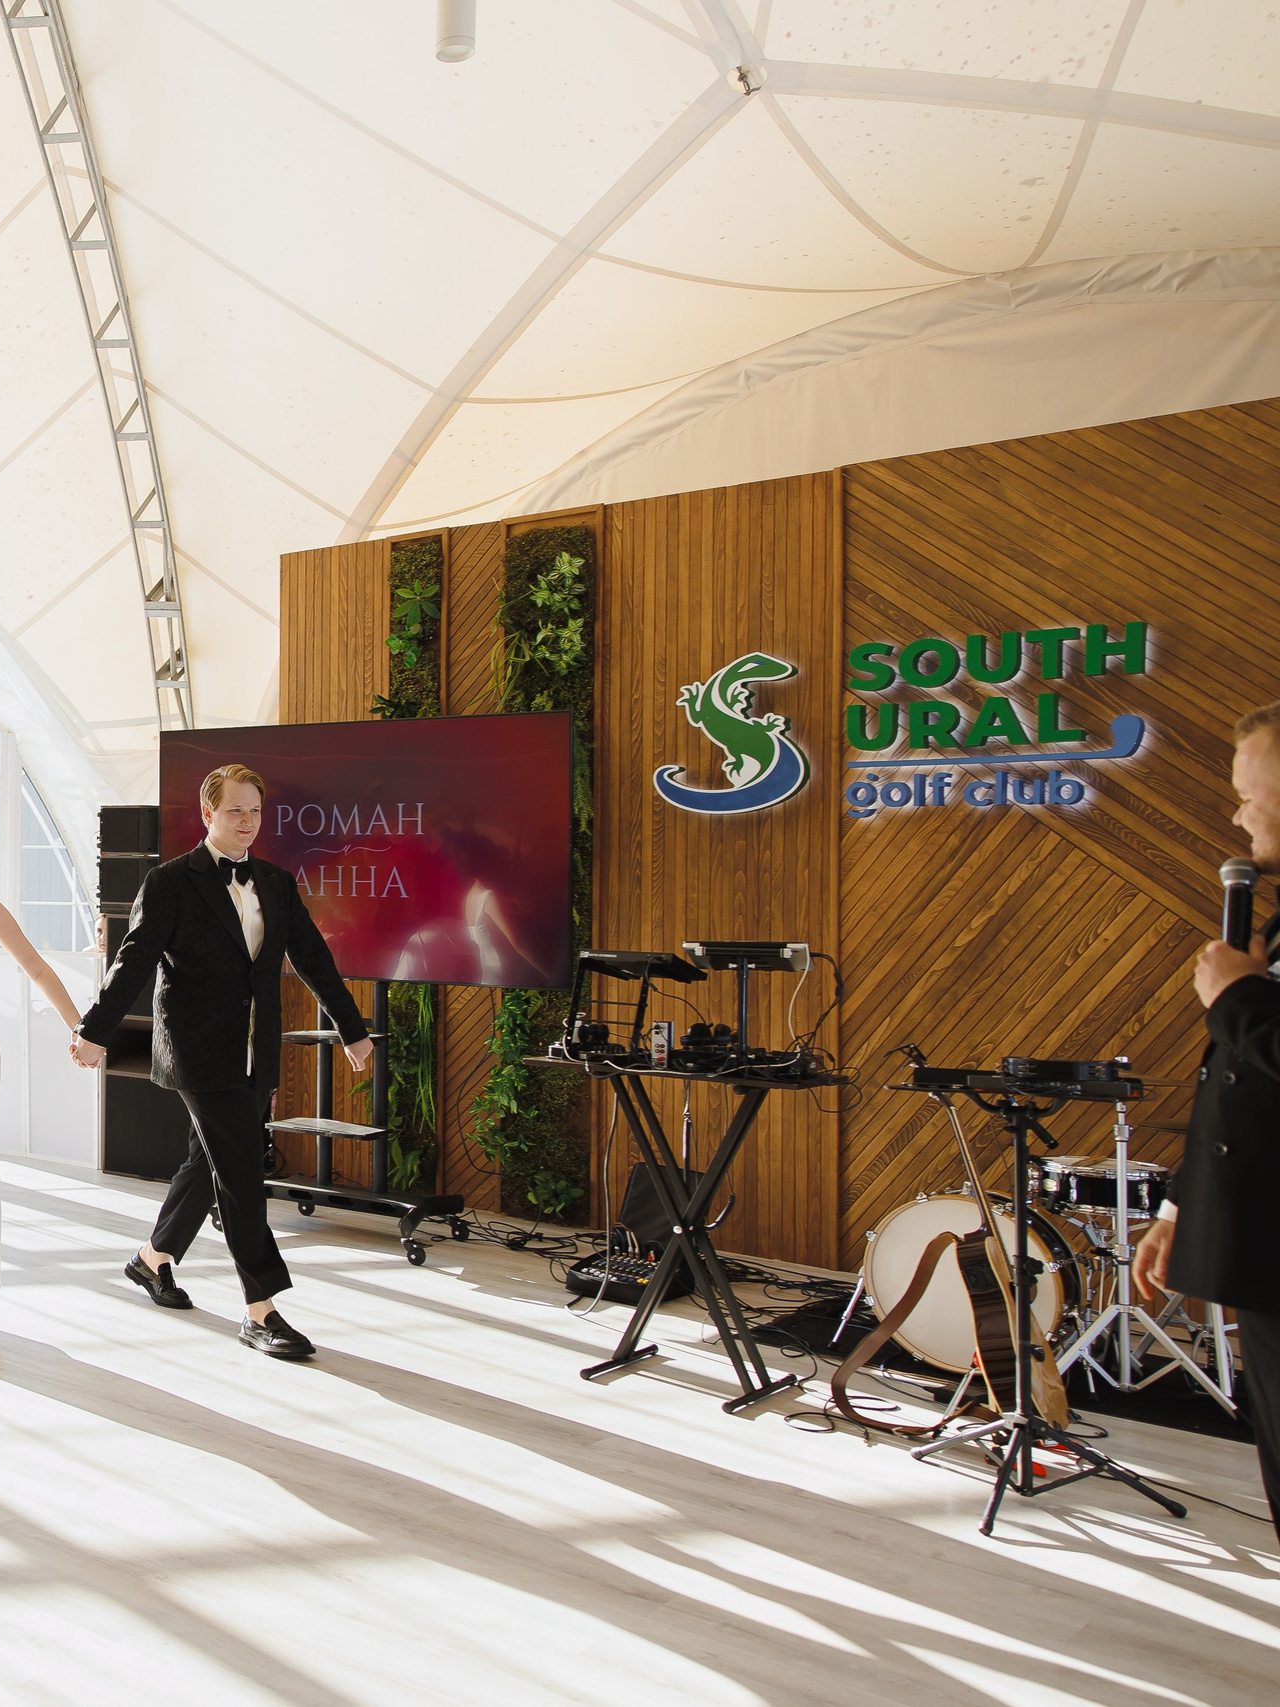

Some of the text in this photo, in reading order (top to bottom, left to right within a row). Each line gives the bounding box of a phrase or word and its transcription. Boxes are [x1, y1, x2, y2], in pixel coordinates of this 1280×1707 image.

[848, 621, 1148, 692] SOUTH
[846, 693, 1087, 752] URAL
[846, 769, 1085, 818] golf club
[275, 802, 425, 836] РОМАН
[295, 865, 410, 898] АННА
